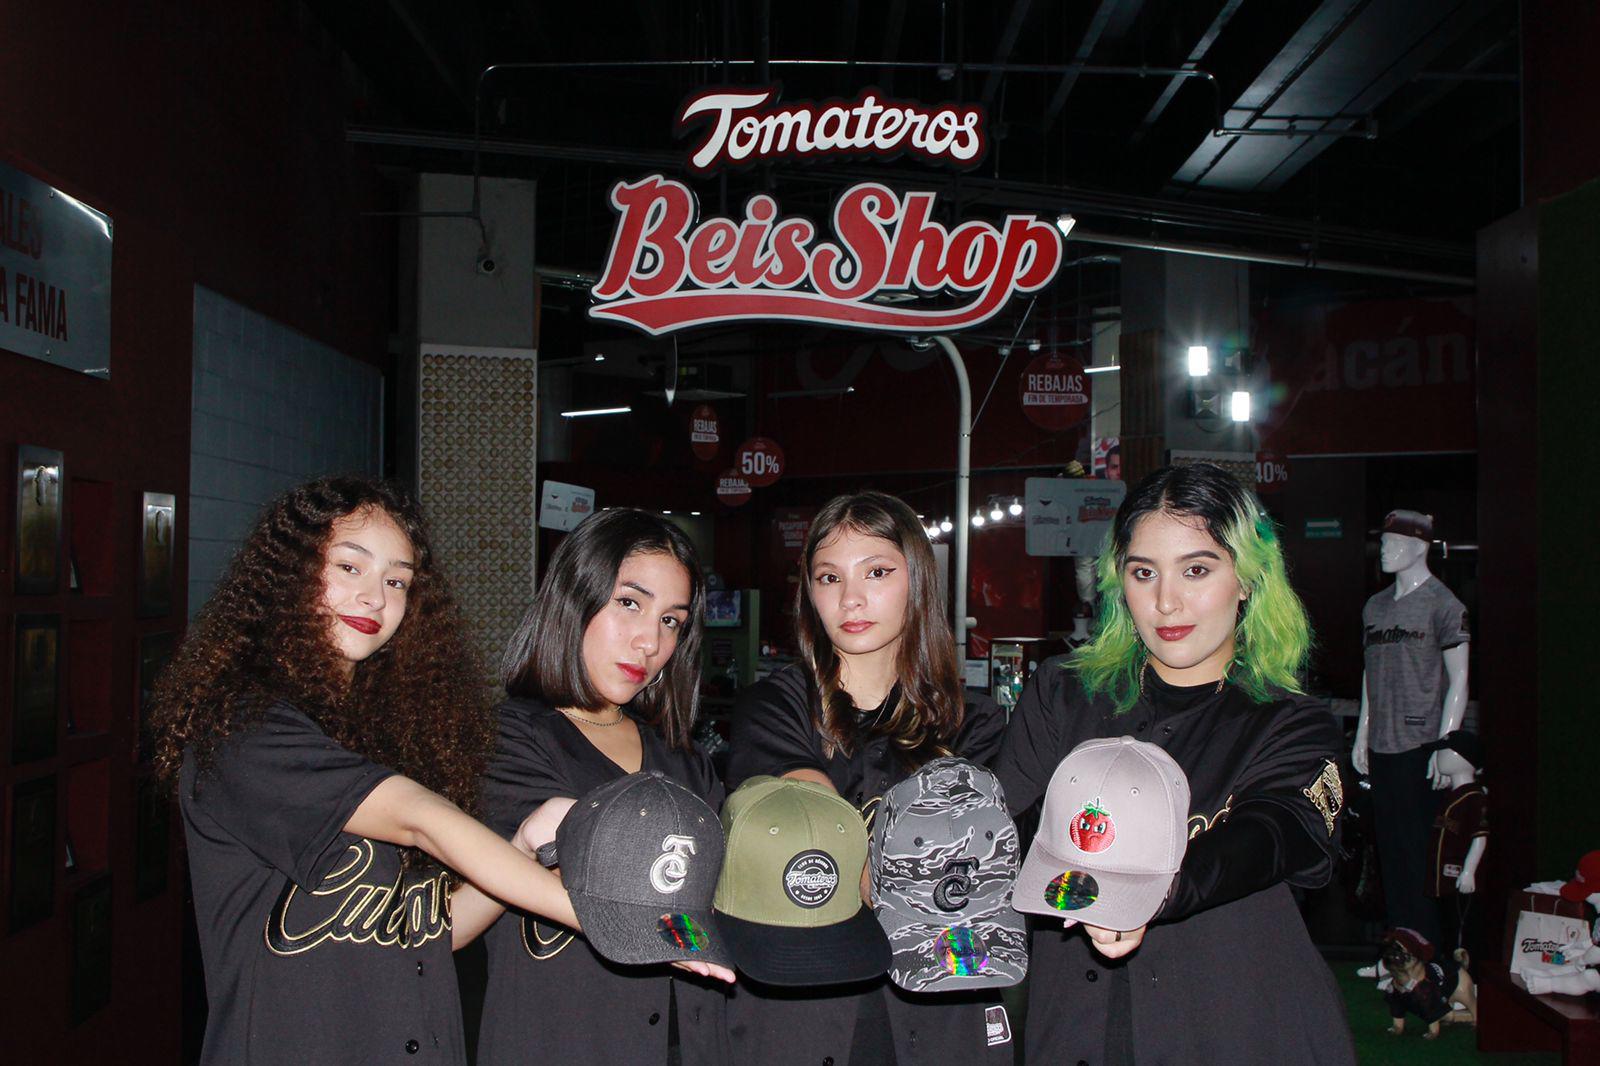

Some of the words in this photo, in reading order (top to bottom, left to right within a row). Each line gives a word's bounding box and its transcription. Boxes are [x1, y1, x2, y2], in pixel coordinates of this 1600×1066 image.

[682, 93, 979, 168] Tomateros
[15, 272, 68, 342] FAMA
[1028, 374, 1083, 393] REBAJAS
[1027, 395, 1038, 404] FIN
[1039, 395, 1046, 404] DE
[1048, 395, 1083, 404] TEMPORADA
[741, 451, 779, 475] 50%
[785, 871, 838, 887] Tomateros
